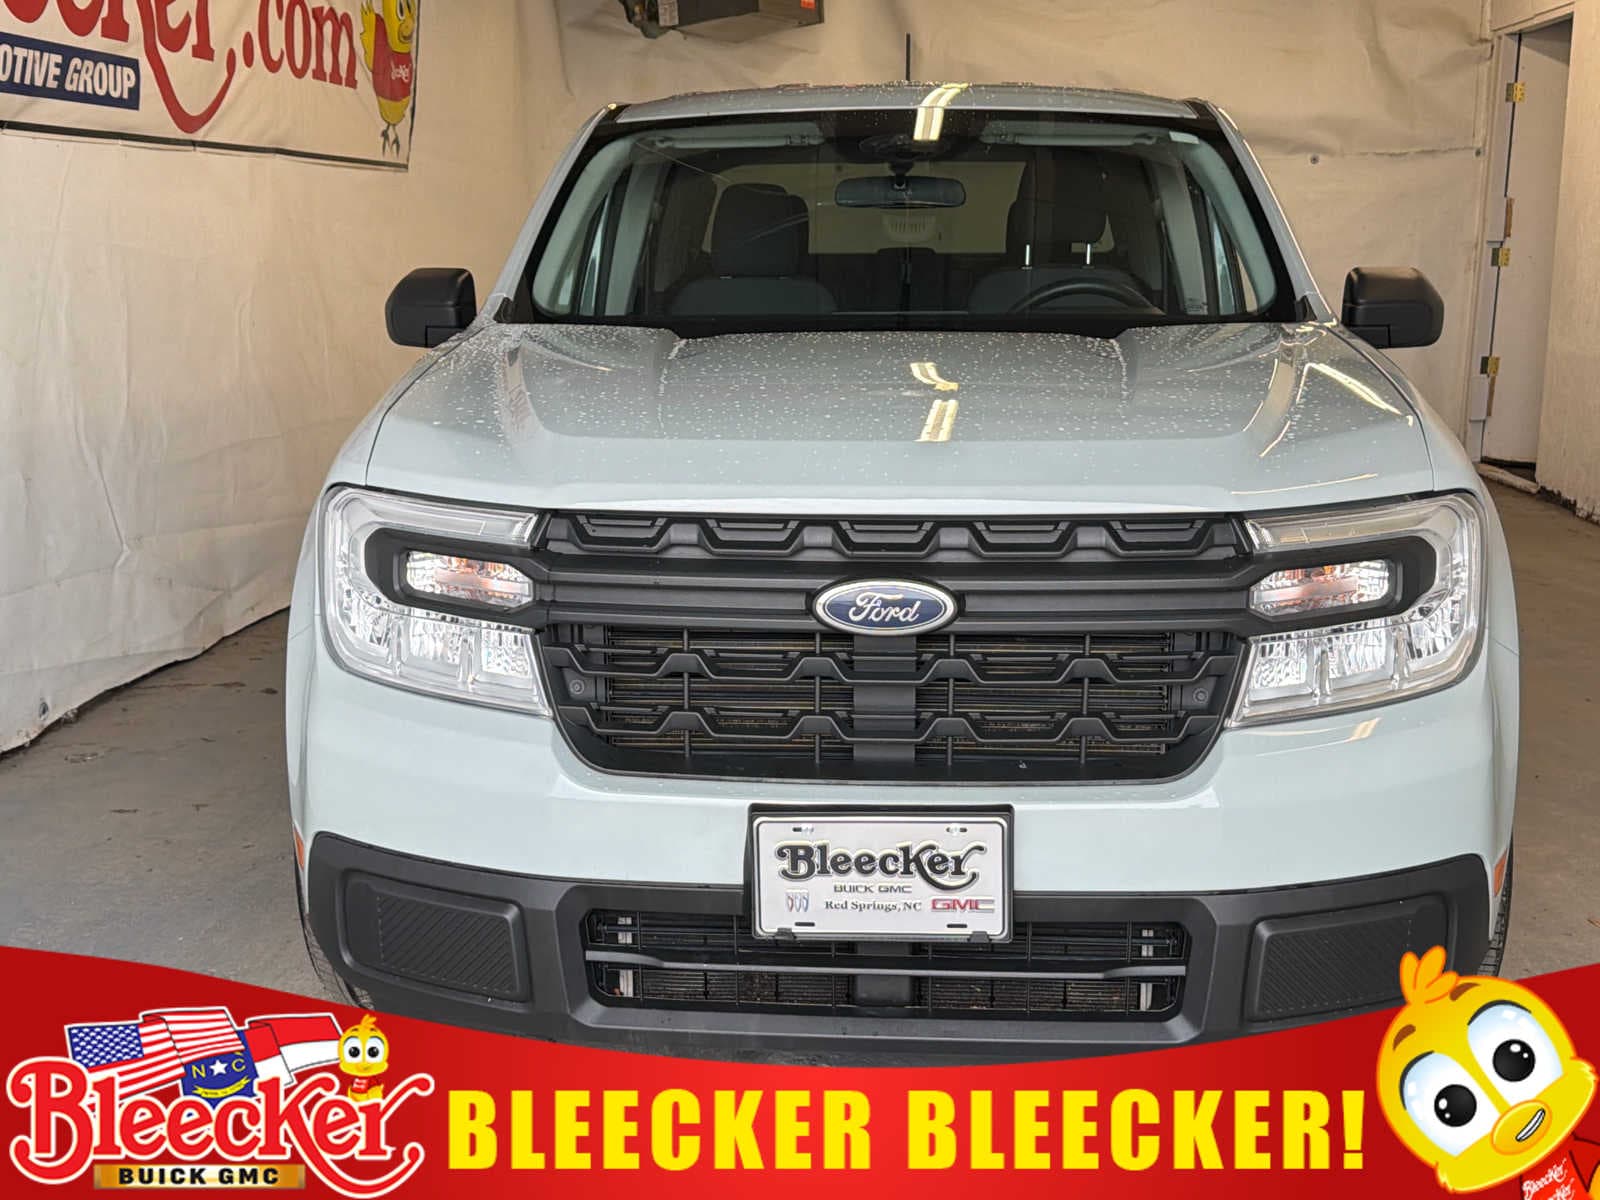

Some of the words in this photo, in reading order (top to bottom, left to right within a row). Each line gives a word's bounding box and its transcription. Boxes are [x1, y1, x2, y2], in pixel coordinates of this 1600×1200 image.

[64, 57, 137, 99] GROUP
[848, 591, 922, 622] Ford
[833, 884, 874, 894] BUICK
[878, 884, 912, 894] GMC
[824, 900, 848, 911] Red
[851, 900, 901, 913] Springs,
[901, 901, 922, 912] NC
[931, 898, 995, 914] GMC
